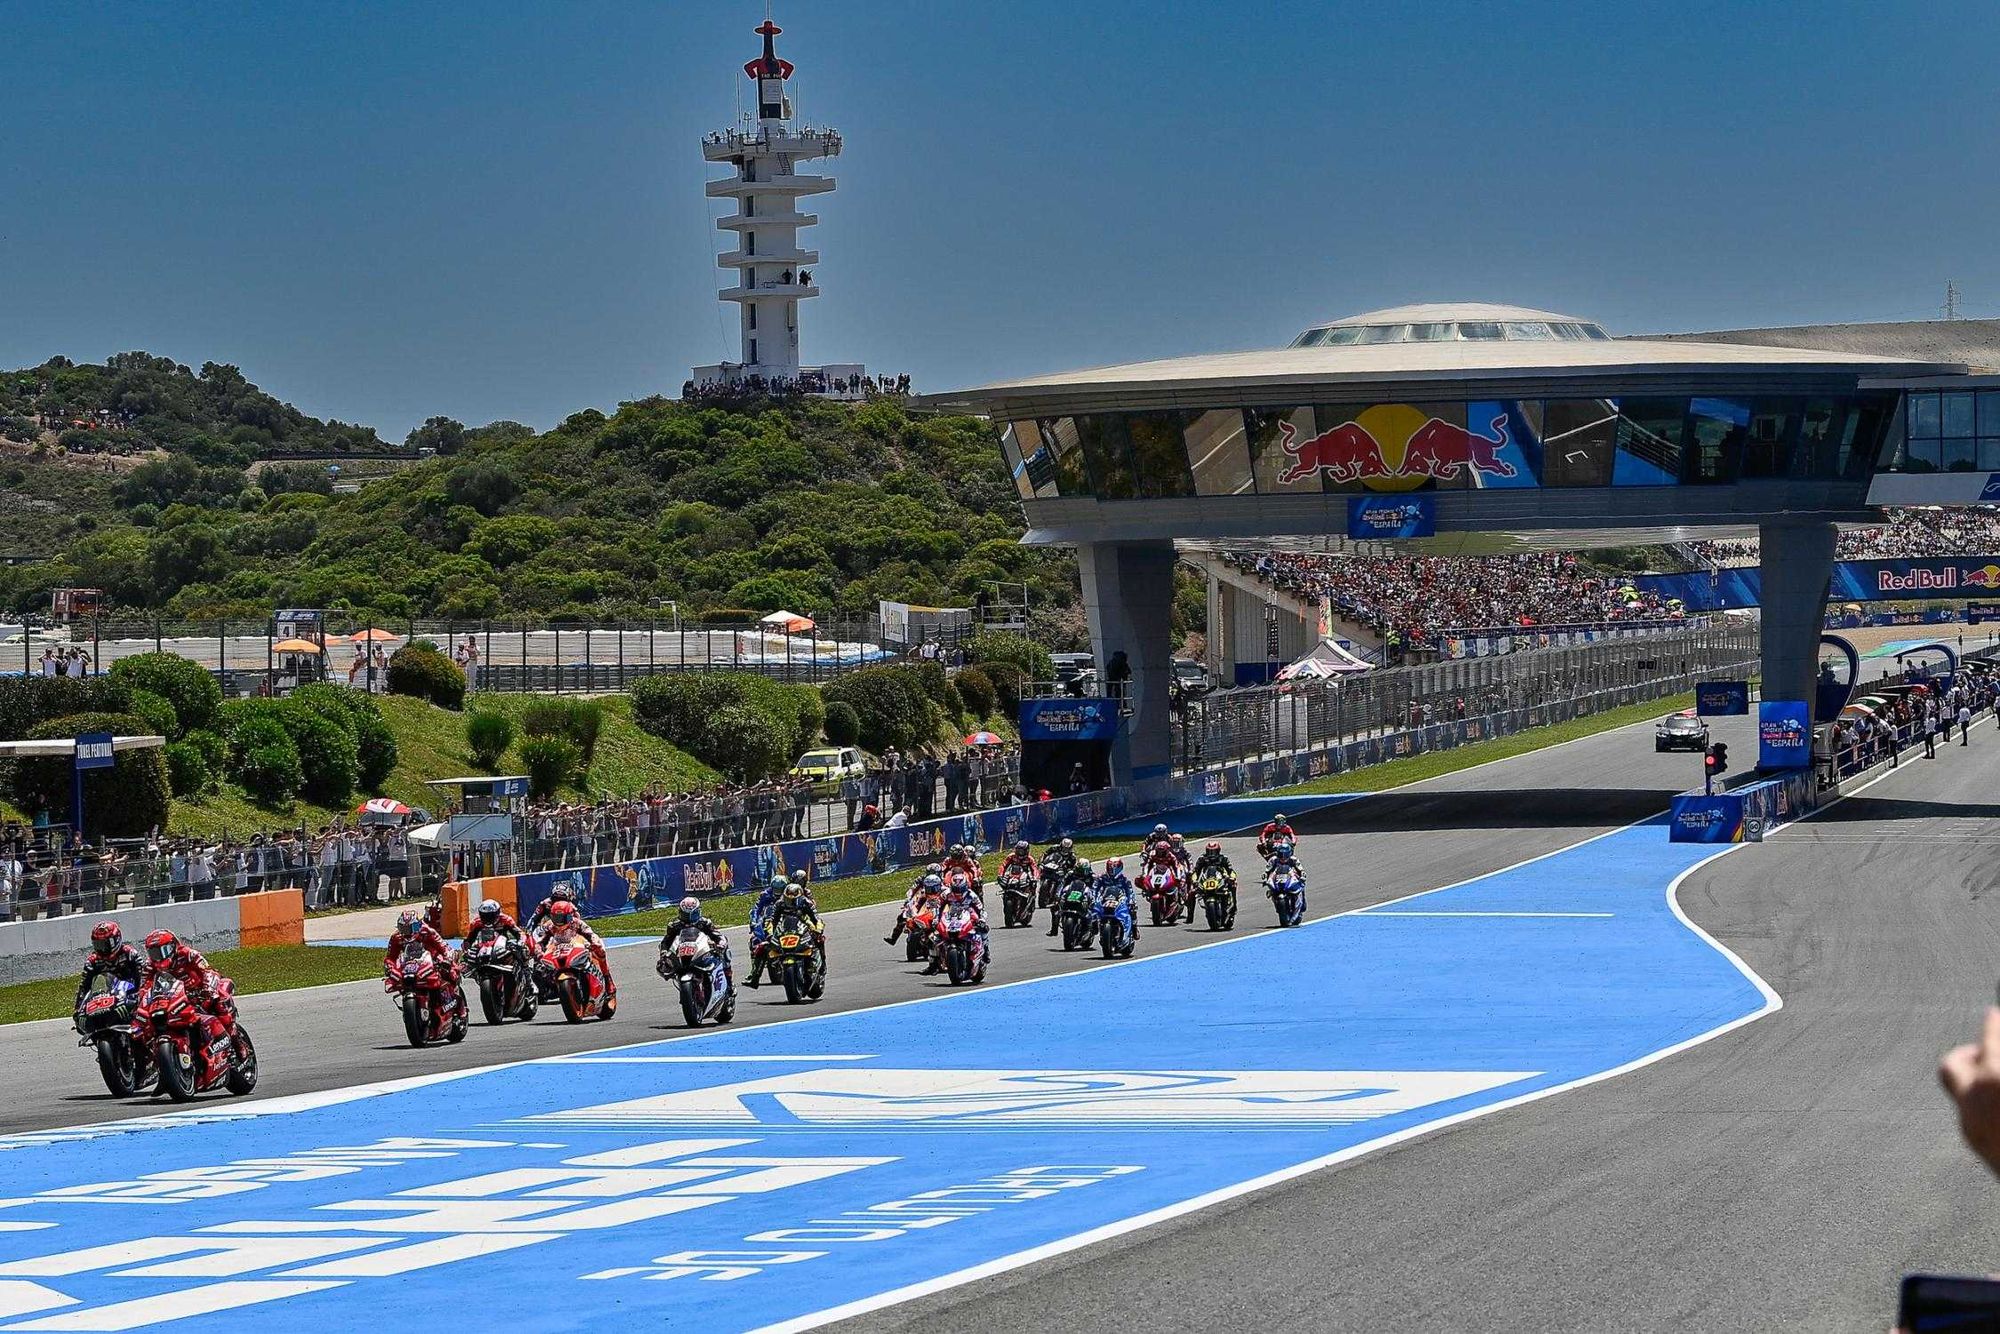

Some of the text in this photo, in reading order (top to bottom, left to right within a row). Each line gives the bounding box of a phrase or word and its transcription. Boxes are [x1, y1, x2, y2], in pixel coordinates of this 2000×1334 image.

[1878, 567, 1957, 590] Red Bull
[283, 626, 290, 637] 4
[1205, 880, 1217, 889] 10
[781, 936, 798, 947] 72
[208, 1036, 230, 1053] Lenovo
[577, 1165, 1146, 1281] CIRCUITO DE
